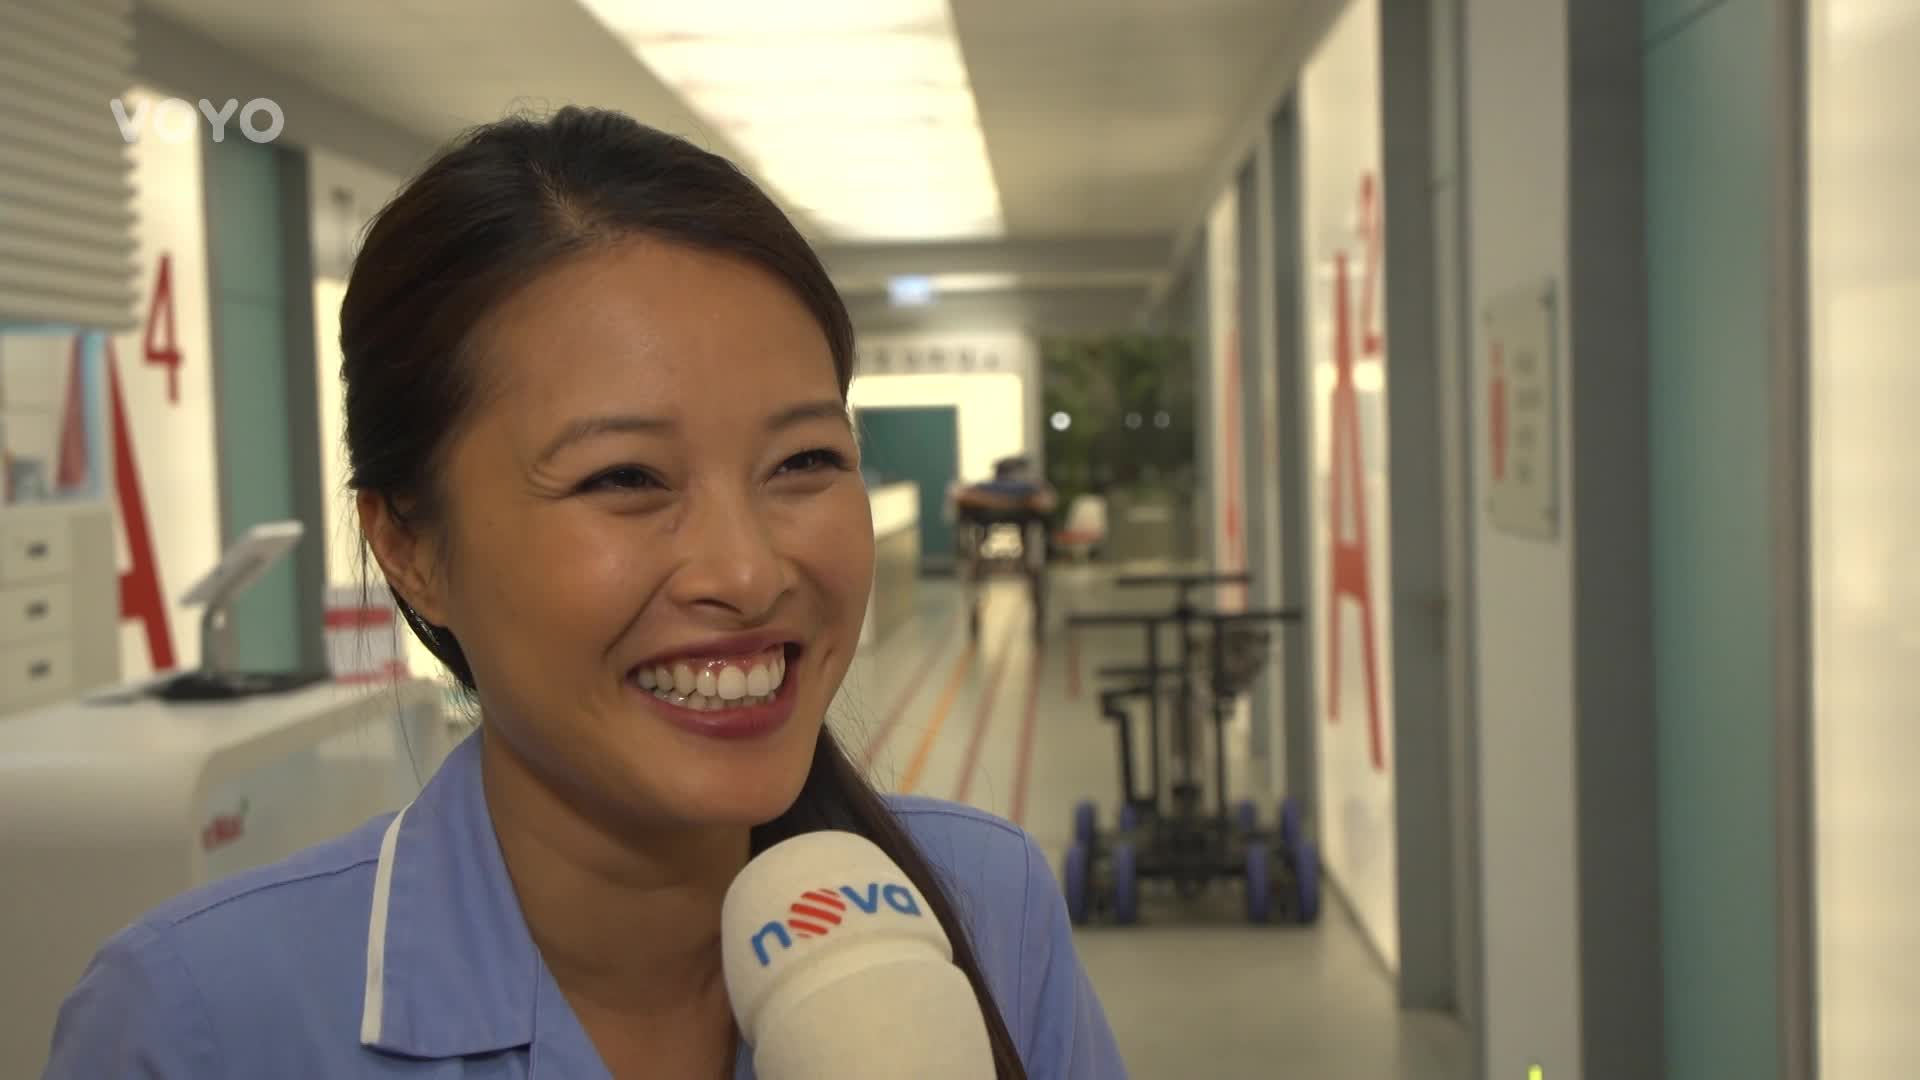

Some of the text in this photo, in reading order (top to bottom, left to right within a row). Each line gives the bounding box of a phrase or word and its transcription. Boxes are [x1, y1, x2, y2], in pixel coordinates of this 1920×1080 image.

[143, 252, 183, 405] 4
[1327, 251, 1386, 772] A
[751, 883, 922, 967] nova
